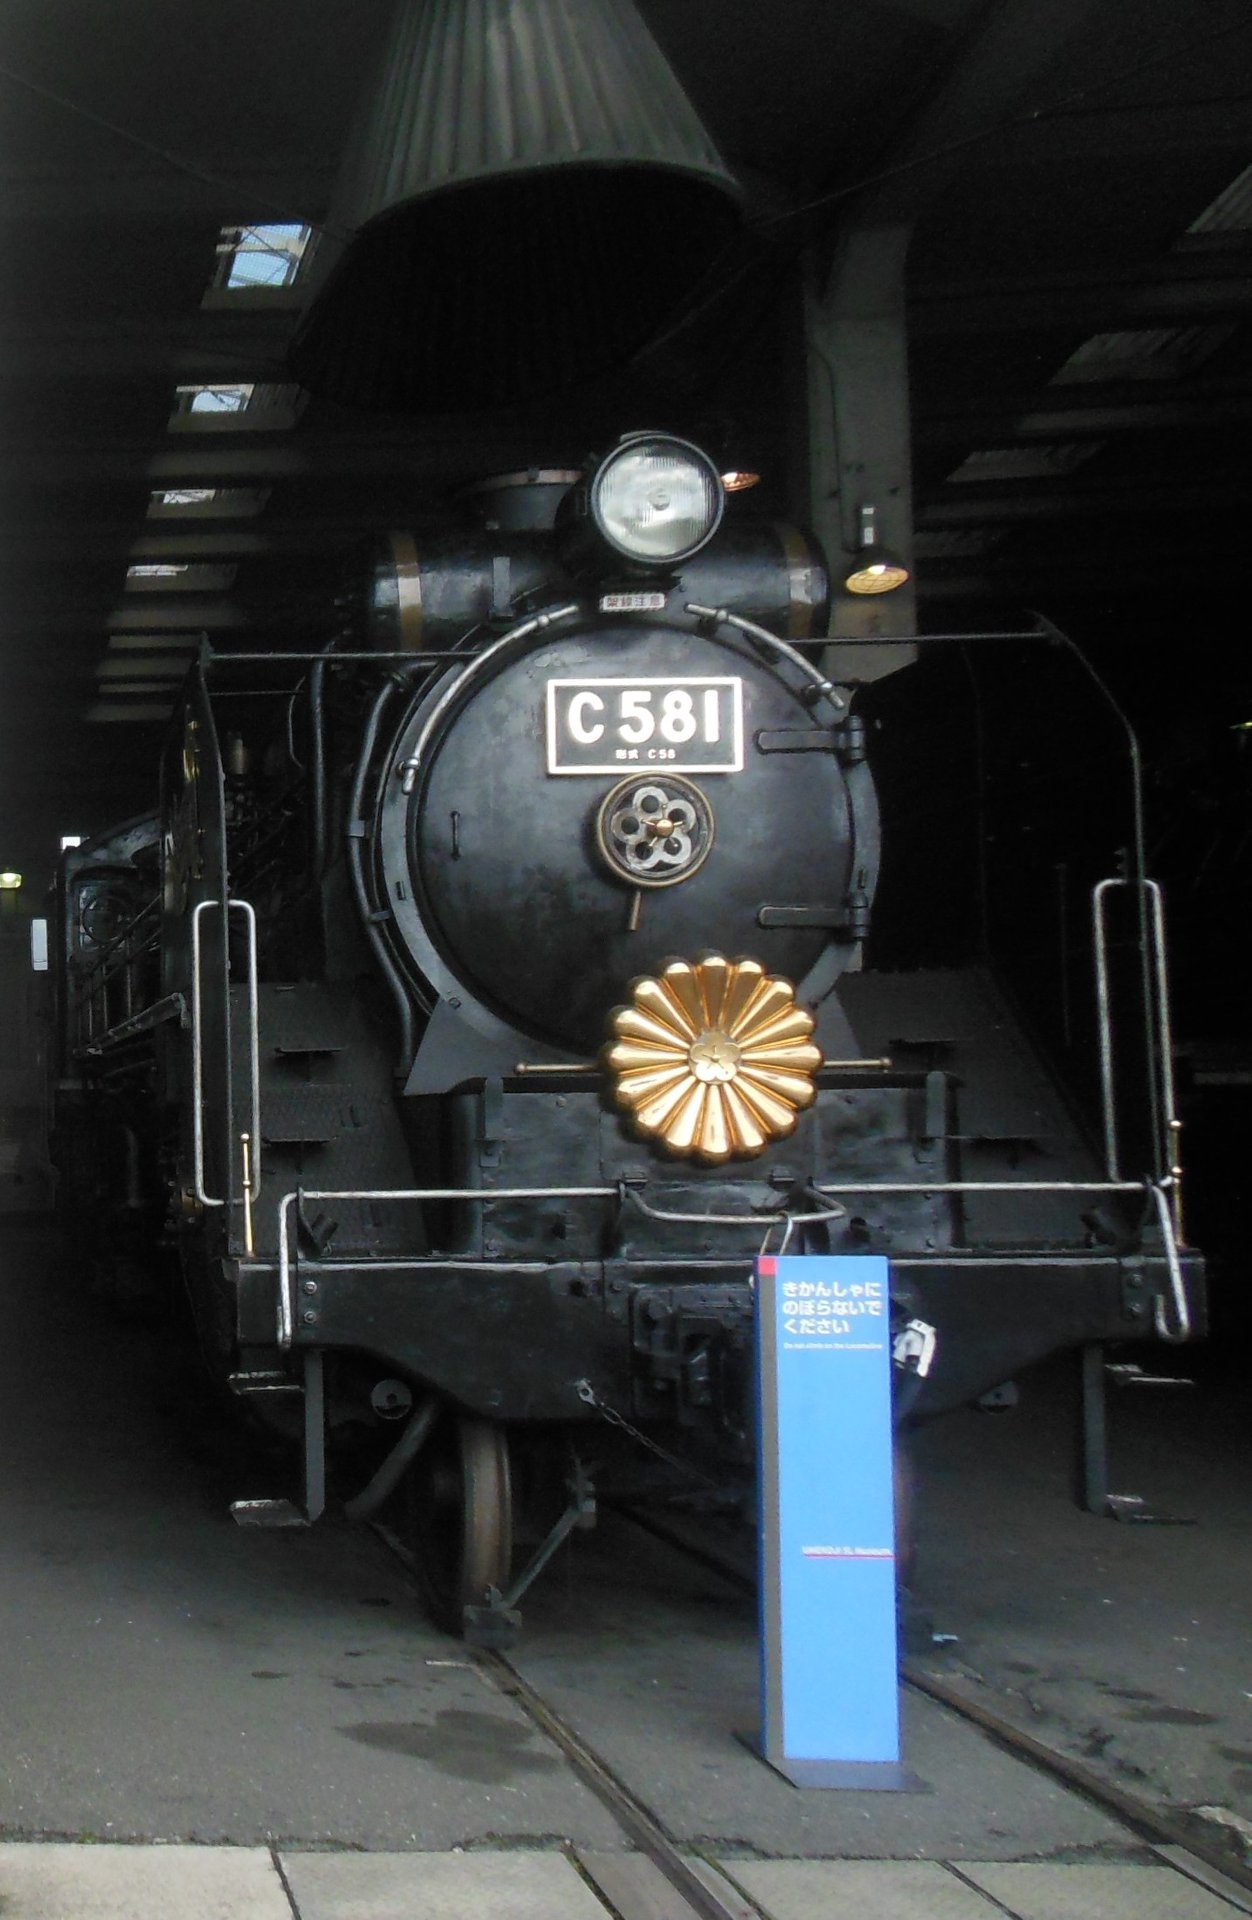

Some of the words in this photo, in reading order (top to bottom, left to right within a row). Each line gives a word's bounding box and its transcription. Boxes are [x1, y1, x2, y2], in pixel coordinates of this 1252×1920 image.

[783, 1281, 881, 1298] きかんしゃに
[782, 1300, 882, 1316] のぼらないで
[783, 1319, 850, 1335] ください
